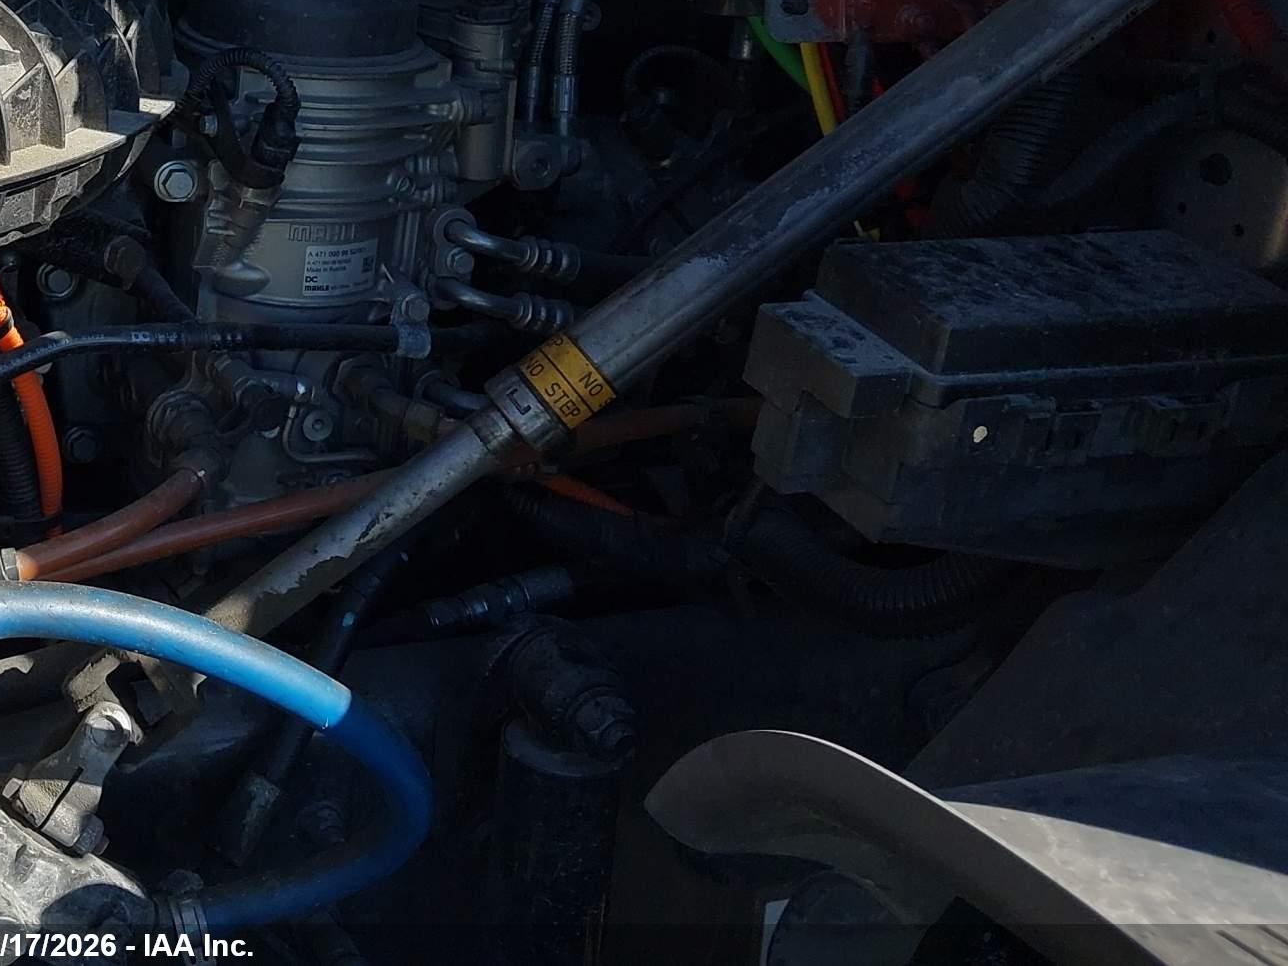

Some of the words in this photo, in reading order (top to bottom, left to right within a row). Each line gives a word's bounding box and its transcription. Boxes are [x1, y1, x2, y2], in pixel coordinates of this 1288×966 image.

[131, 331, 150, 342] DC
[579, 371, 603, 397] NO
[545, 383, 581, 418] STEP
